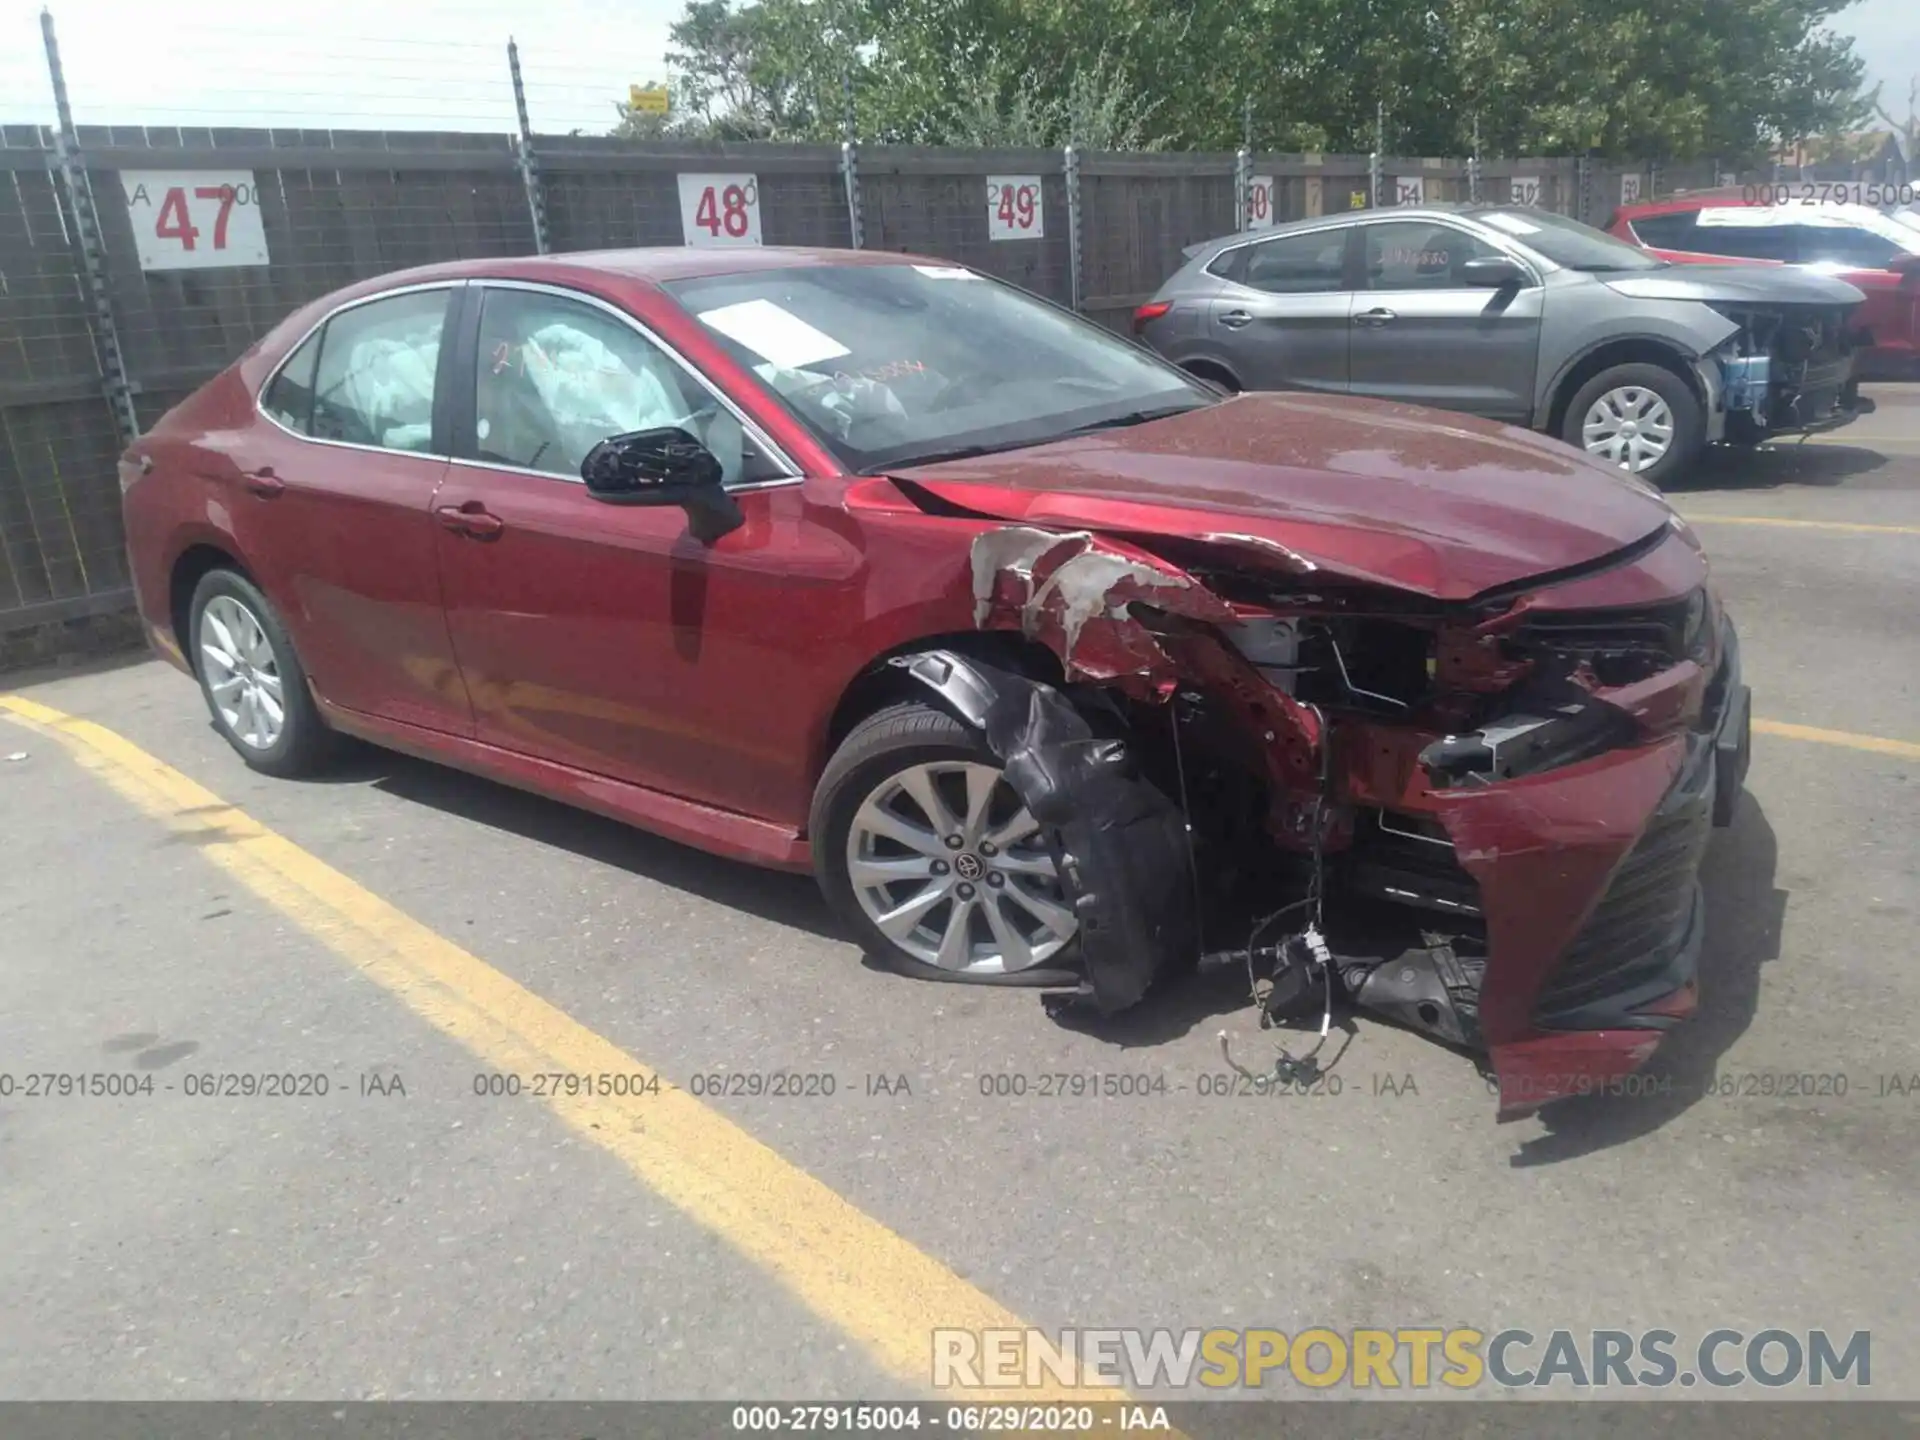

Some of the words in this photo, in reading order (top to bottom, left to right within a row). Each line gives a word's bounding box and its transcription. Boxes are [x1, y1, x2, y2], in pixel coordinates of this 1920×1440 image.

[156, 187, 236, 251] 47
[695, 185, 749, 238] 48
[997, 184, 1035, 230] 49
